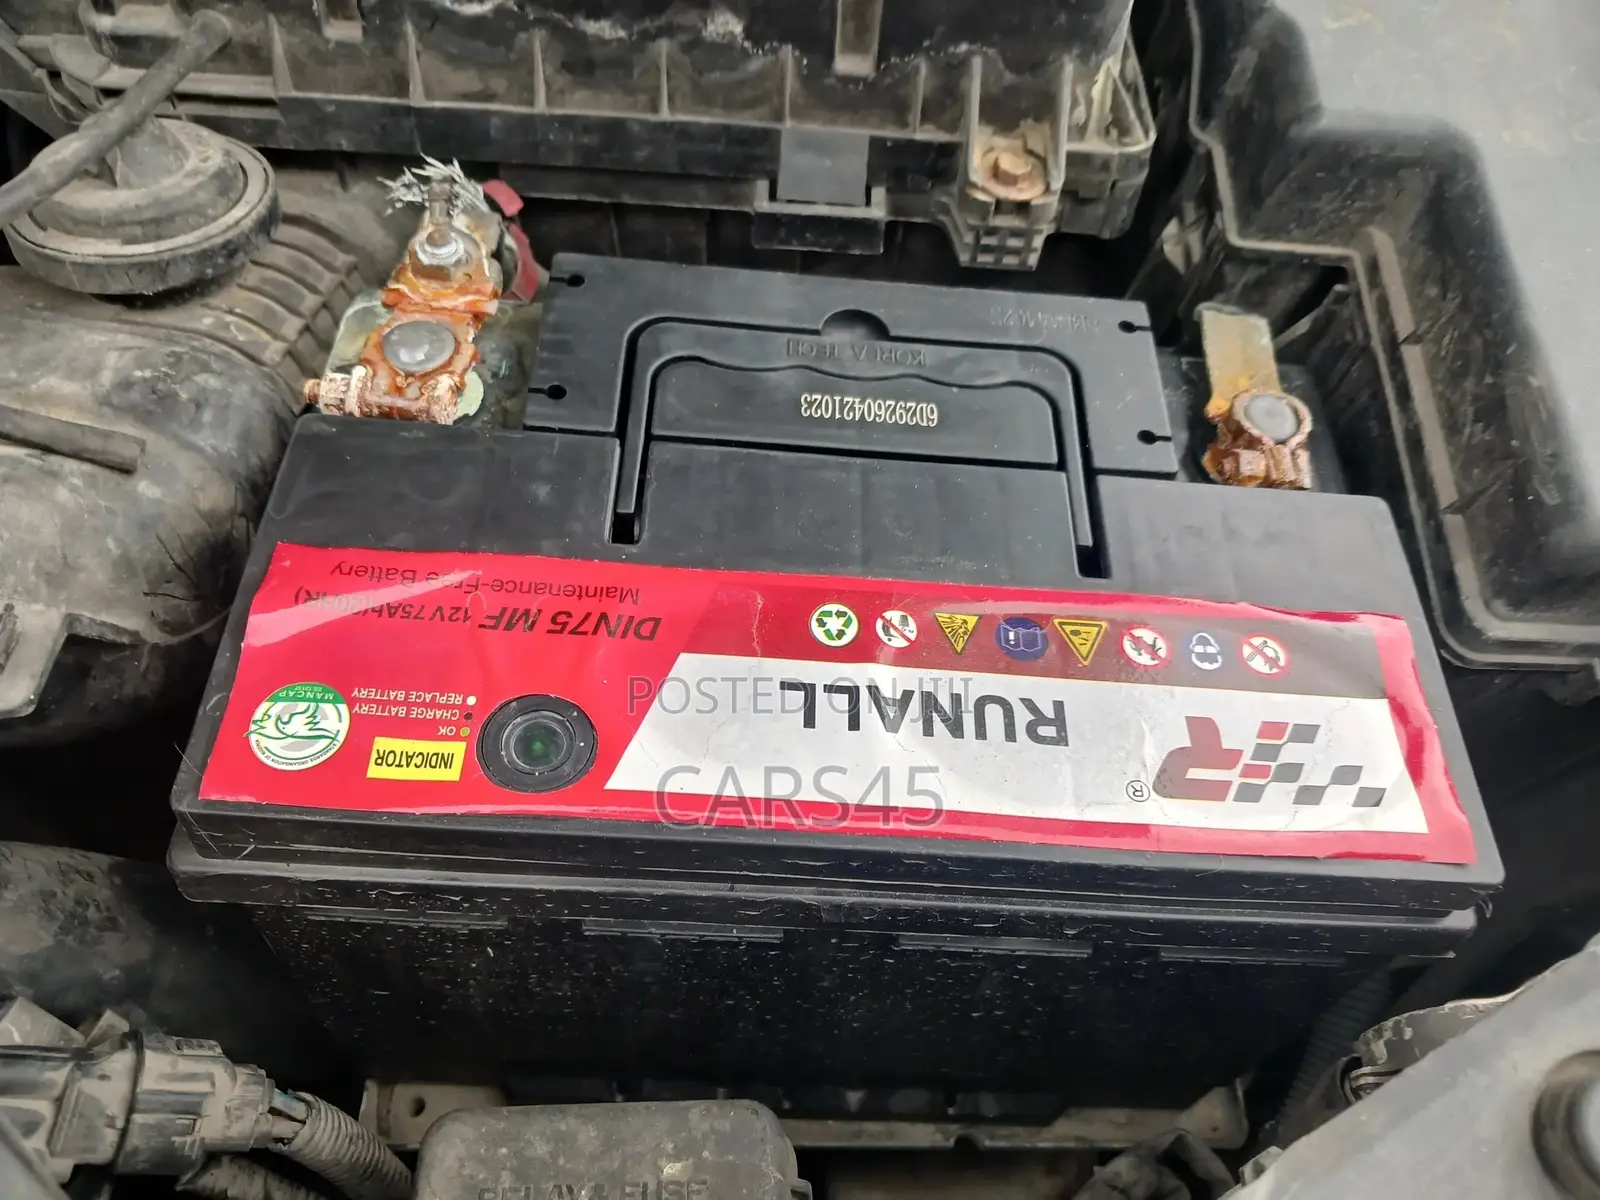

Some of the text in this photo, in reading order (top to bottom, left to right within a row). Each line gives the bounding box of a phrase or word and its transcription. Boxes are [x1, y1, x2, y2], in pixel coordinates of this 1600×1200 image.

[800, 392, 939, 428] 6D29260421023
[330, 561, 640, 606] Maintenance-Free Battery
[477, 606, 538, 633] MF
[545, 609, 662, 643] DIN75
[278, 691, 335, 700] MANCAP
[351, 687, 464, 705] REPLACE BATTERY
[351, 703, 460, 721] CHARGE BATTERY
[779, 680, 1069, 747] RUNALL
[437, 726, 456, 736] OK
[374, 748, 455, 770] INDICATOR
